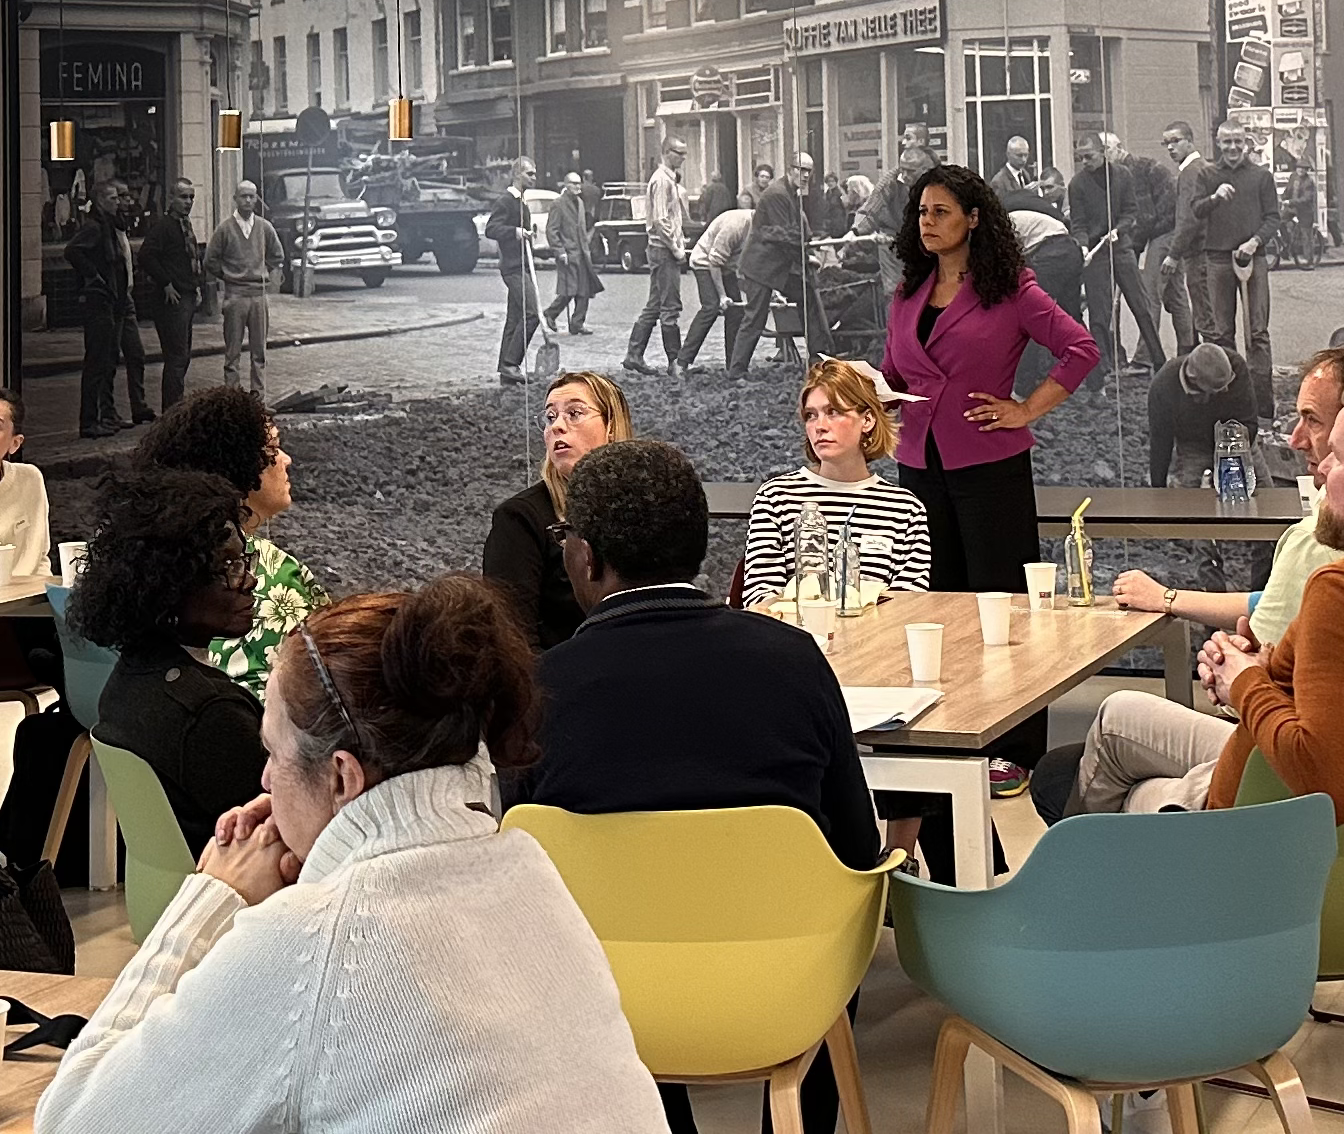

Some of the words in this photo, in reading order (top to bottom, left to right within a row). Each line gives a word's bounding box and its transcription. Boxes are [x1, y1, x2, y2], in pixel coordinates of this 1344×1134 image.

[834, 19, 857, 44] VAN
[860, 13, 897, 41] NELLE
[899, 5, 938, 36] THEE
[59, 61, 142, 91] FEMINA
